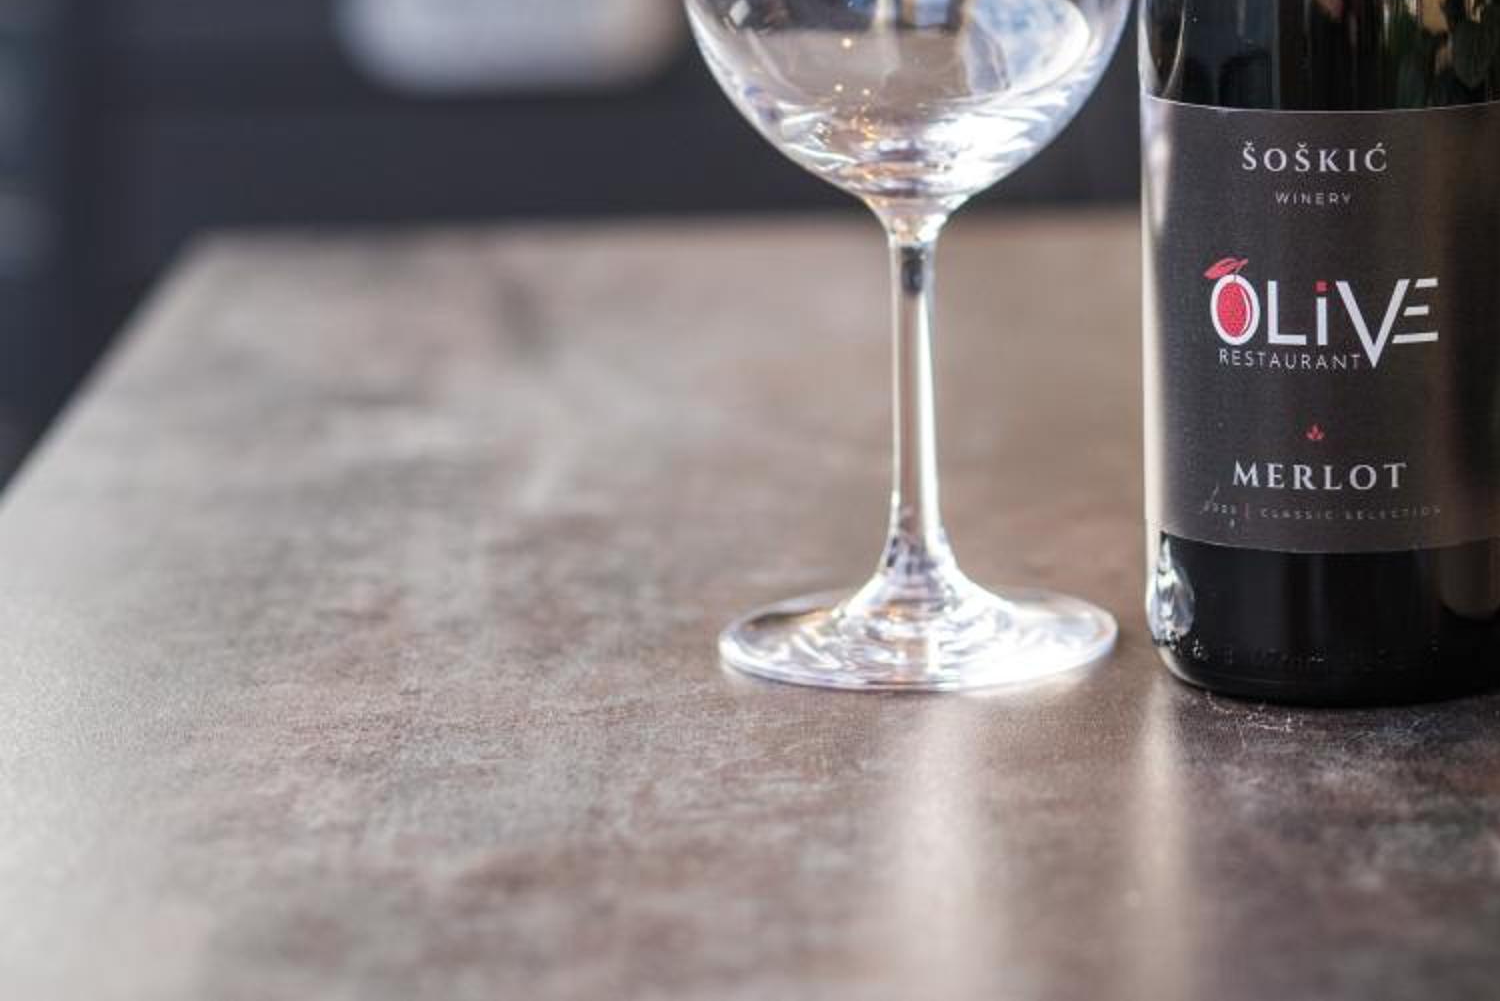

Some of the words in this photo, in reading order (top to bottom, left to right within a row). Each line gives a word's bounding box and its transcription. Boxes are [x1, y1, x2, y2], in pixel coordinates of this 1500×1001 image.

[1241, 140, 1389, 173] ŠOŠKIĆ
[1275, 191, 1352, 206] WINERY
[1218, 348, 1362, 371] RESTAURANT
[1233, 459, 1408, 492] MERLOT
